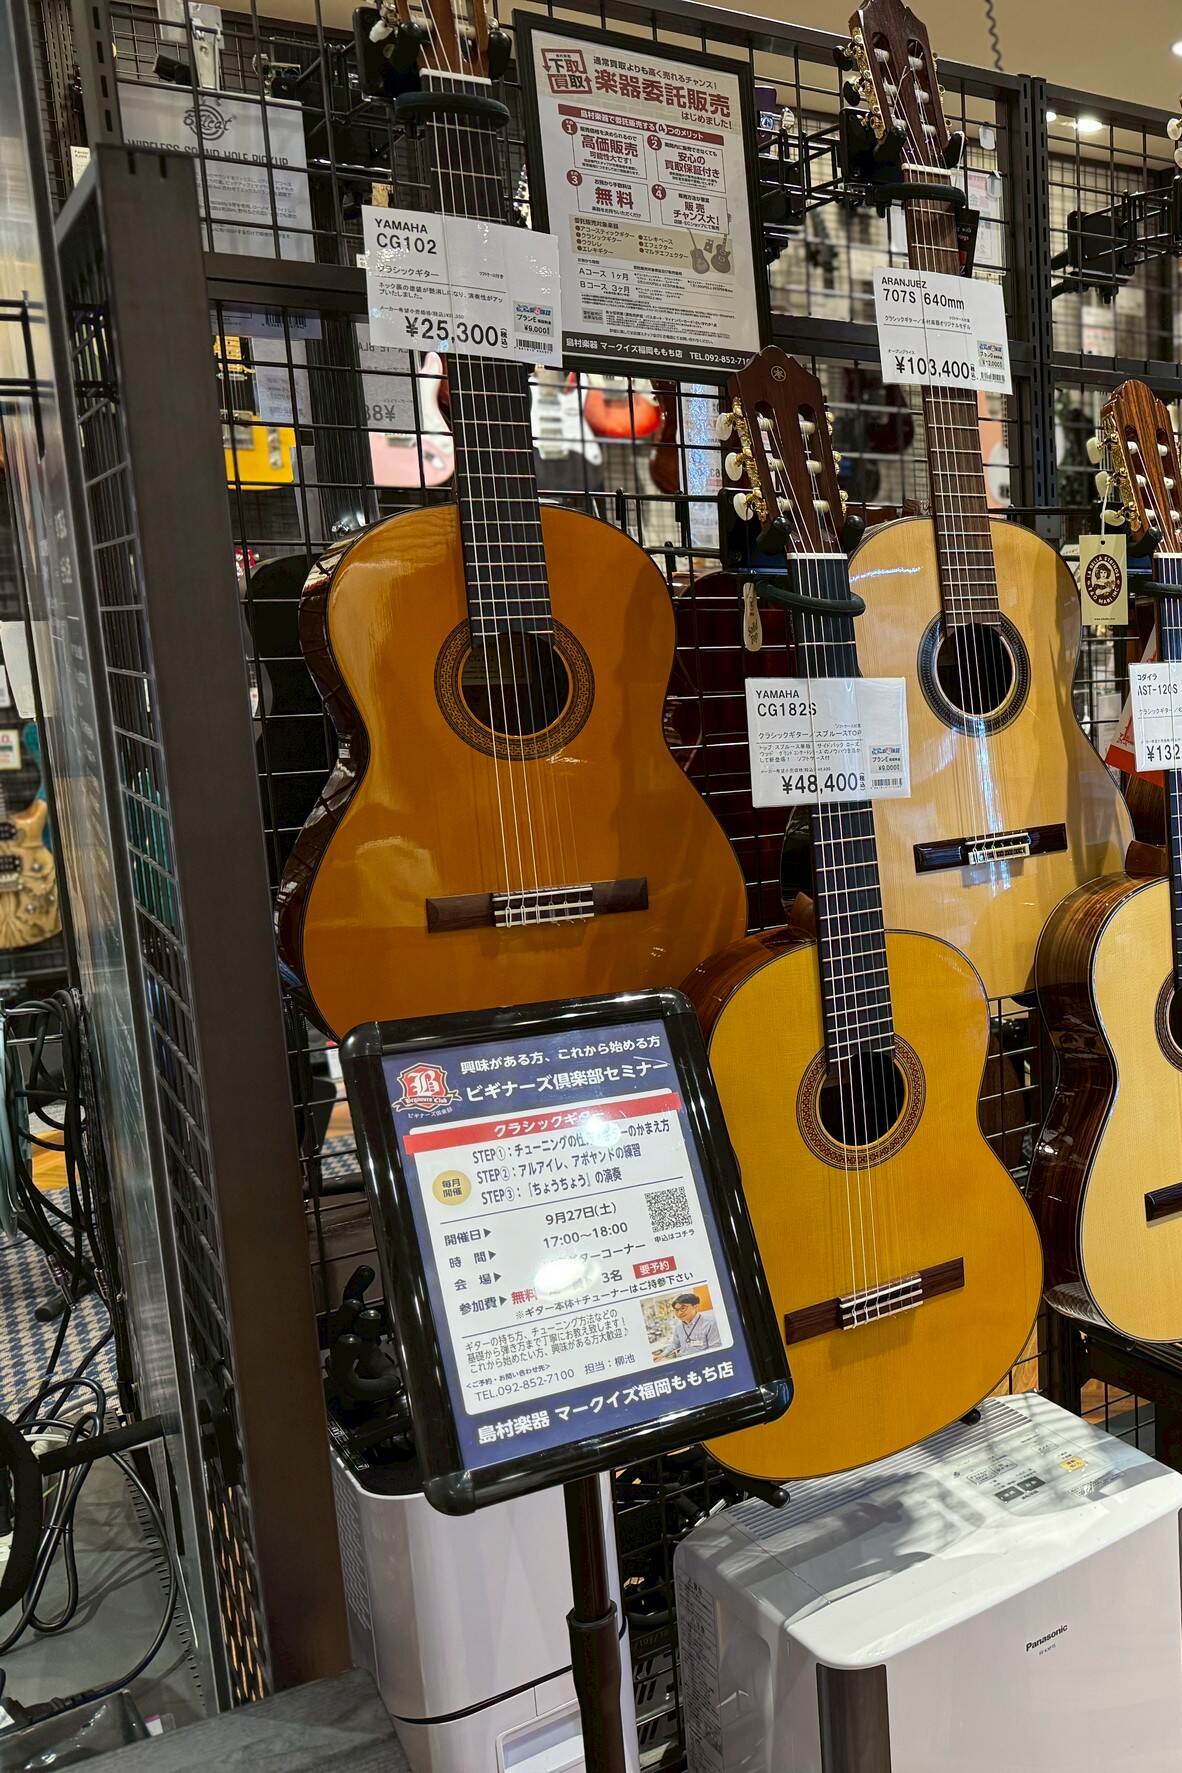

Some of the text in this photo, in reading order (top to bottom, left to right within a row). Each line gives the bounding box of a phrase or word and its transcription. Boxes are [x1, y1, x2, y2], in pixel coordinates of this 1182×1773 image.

[549, 58, 581, 74] 下取
[556, 74, 586, 90] 買取
[594, 69, 731, 118] 楽器委託販売
[581, 134, 639, 157] 高価販売
[677, 152, 706, 165] 安心の
[665, 160, 720, 179] 買取保証付き
[375, 218, 428, 234] YAMAHA
[580, 226, 635, 238] アコースティックギター
[377, 232, 437, 255] CG102
[378, 265, 440, 278] クラシックギター
[881, 276, 927, 289] ARANJUEZ
[883, 288, 965, 310] 707S 640mm
[405, 316, 499, 347] ¥25,300
[566, 338, 598, 350] 島村楽器
[600, 342, 684, 359] マークイズ福岡ももち店
[895, 356, 970, 379] ¥103,400
[1137, 673, 1157, 681] コダイラ
[756, 690, 799, 699] YAMAHA
[757, 702, 817, 717] CG182S
[782, 772, 858, 795] ¥48,400
[466, 1061, 669, 1102] ビギナーズ倶楽部セミナー
[441, 1179, 461, 1188] 毎月
[443, 1188, 462, 1197] 開催
[546, 1202, 617, 1226] 9月27日(土)
[444, 1228, 482, 1247] 開催日
[639, 1259, 670, 1276] 要予約
[459, 1296, 498, 1316] 参加費
[465, 1309, 618, 1352] ギターの持ち方、チューニング方法などの
[474, 1368, 575, 1402] TEL.092-852-7100
[477, 1361, 735, 1445] 島村楽器 マークイズ福岡ももち店
[1026, 1624, 1068, 1652] Panasonic
